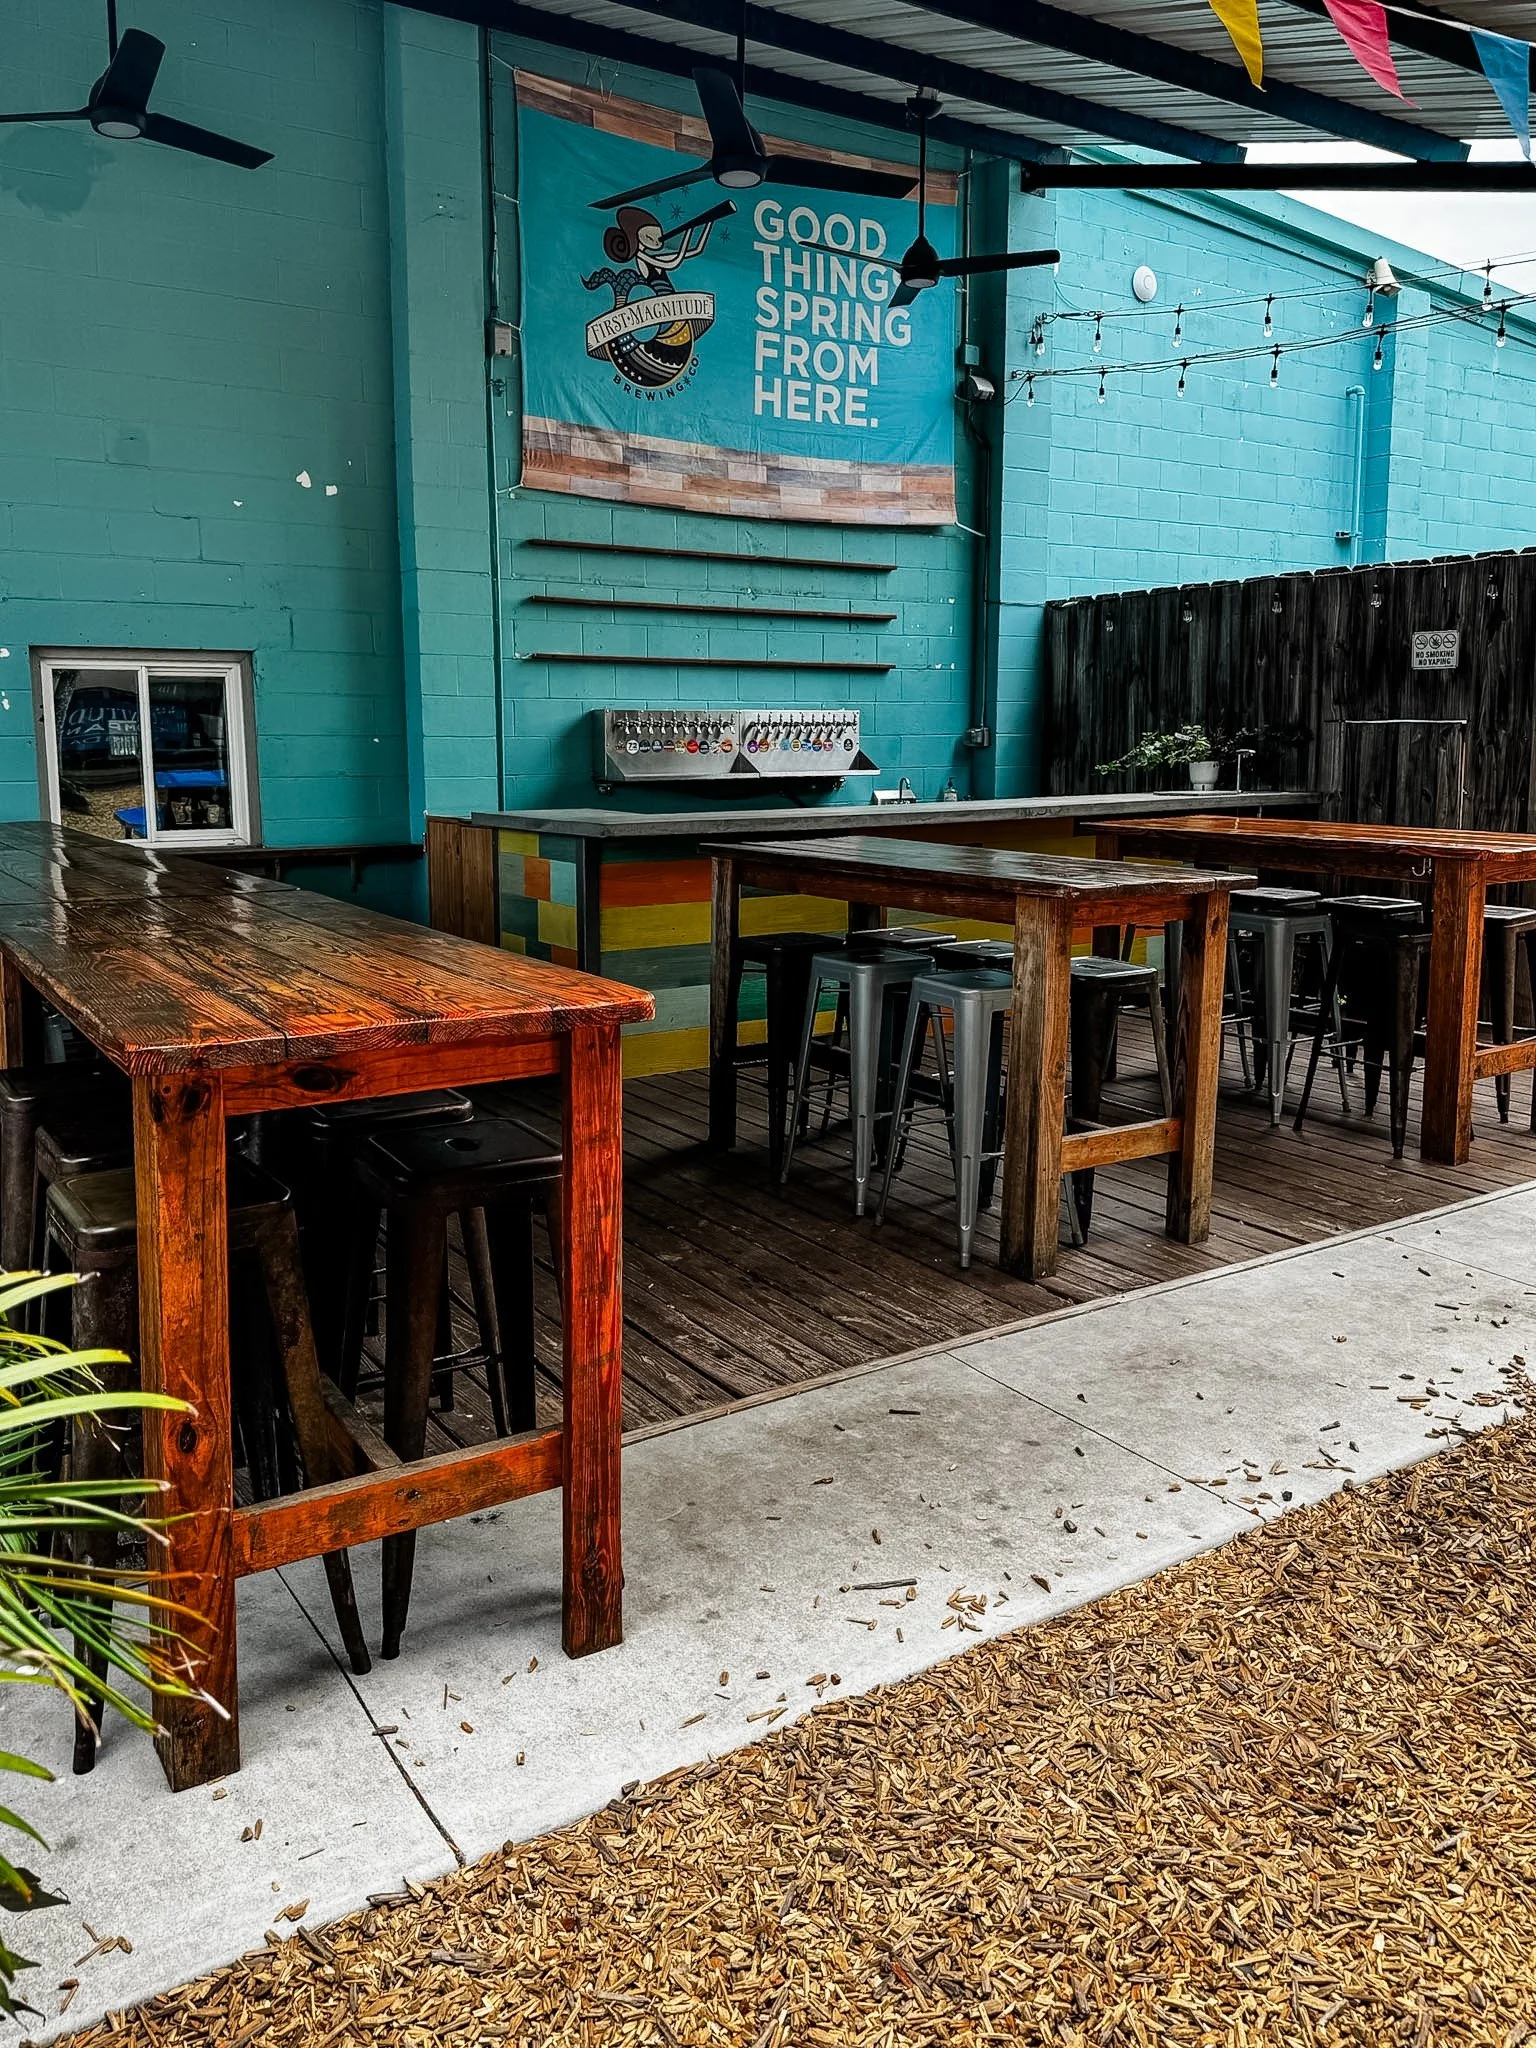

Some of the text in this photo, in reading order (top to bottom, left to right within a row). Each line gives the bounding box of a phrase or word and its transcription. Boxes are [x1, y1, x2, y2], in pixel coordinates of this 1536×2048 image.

[753, 199, 887, 259] GOOD
[753, 241, 903, 303] THING
[754, 286, 912, 347] SPRING
[754, 330, 879, 386] FROM
[613, 374, 684, 401] BREWING
[753, 375, 879, 428] HERE.
[1425, 650, 1454, 658] SMOKING
